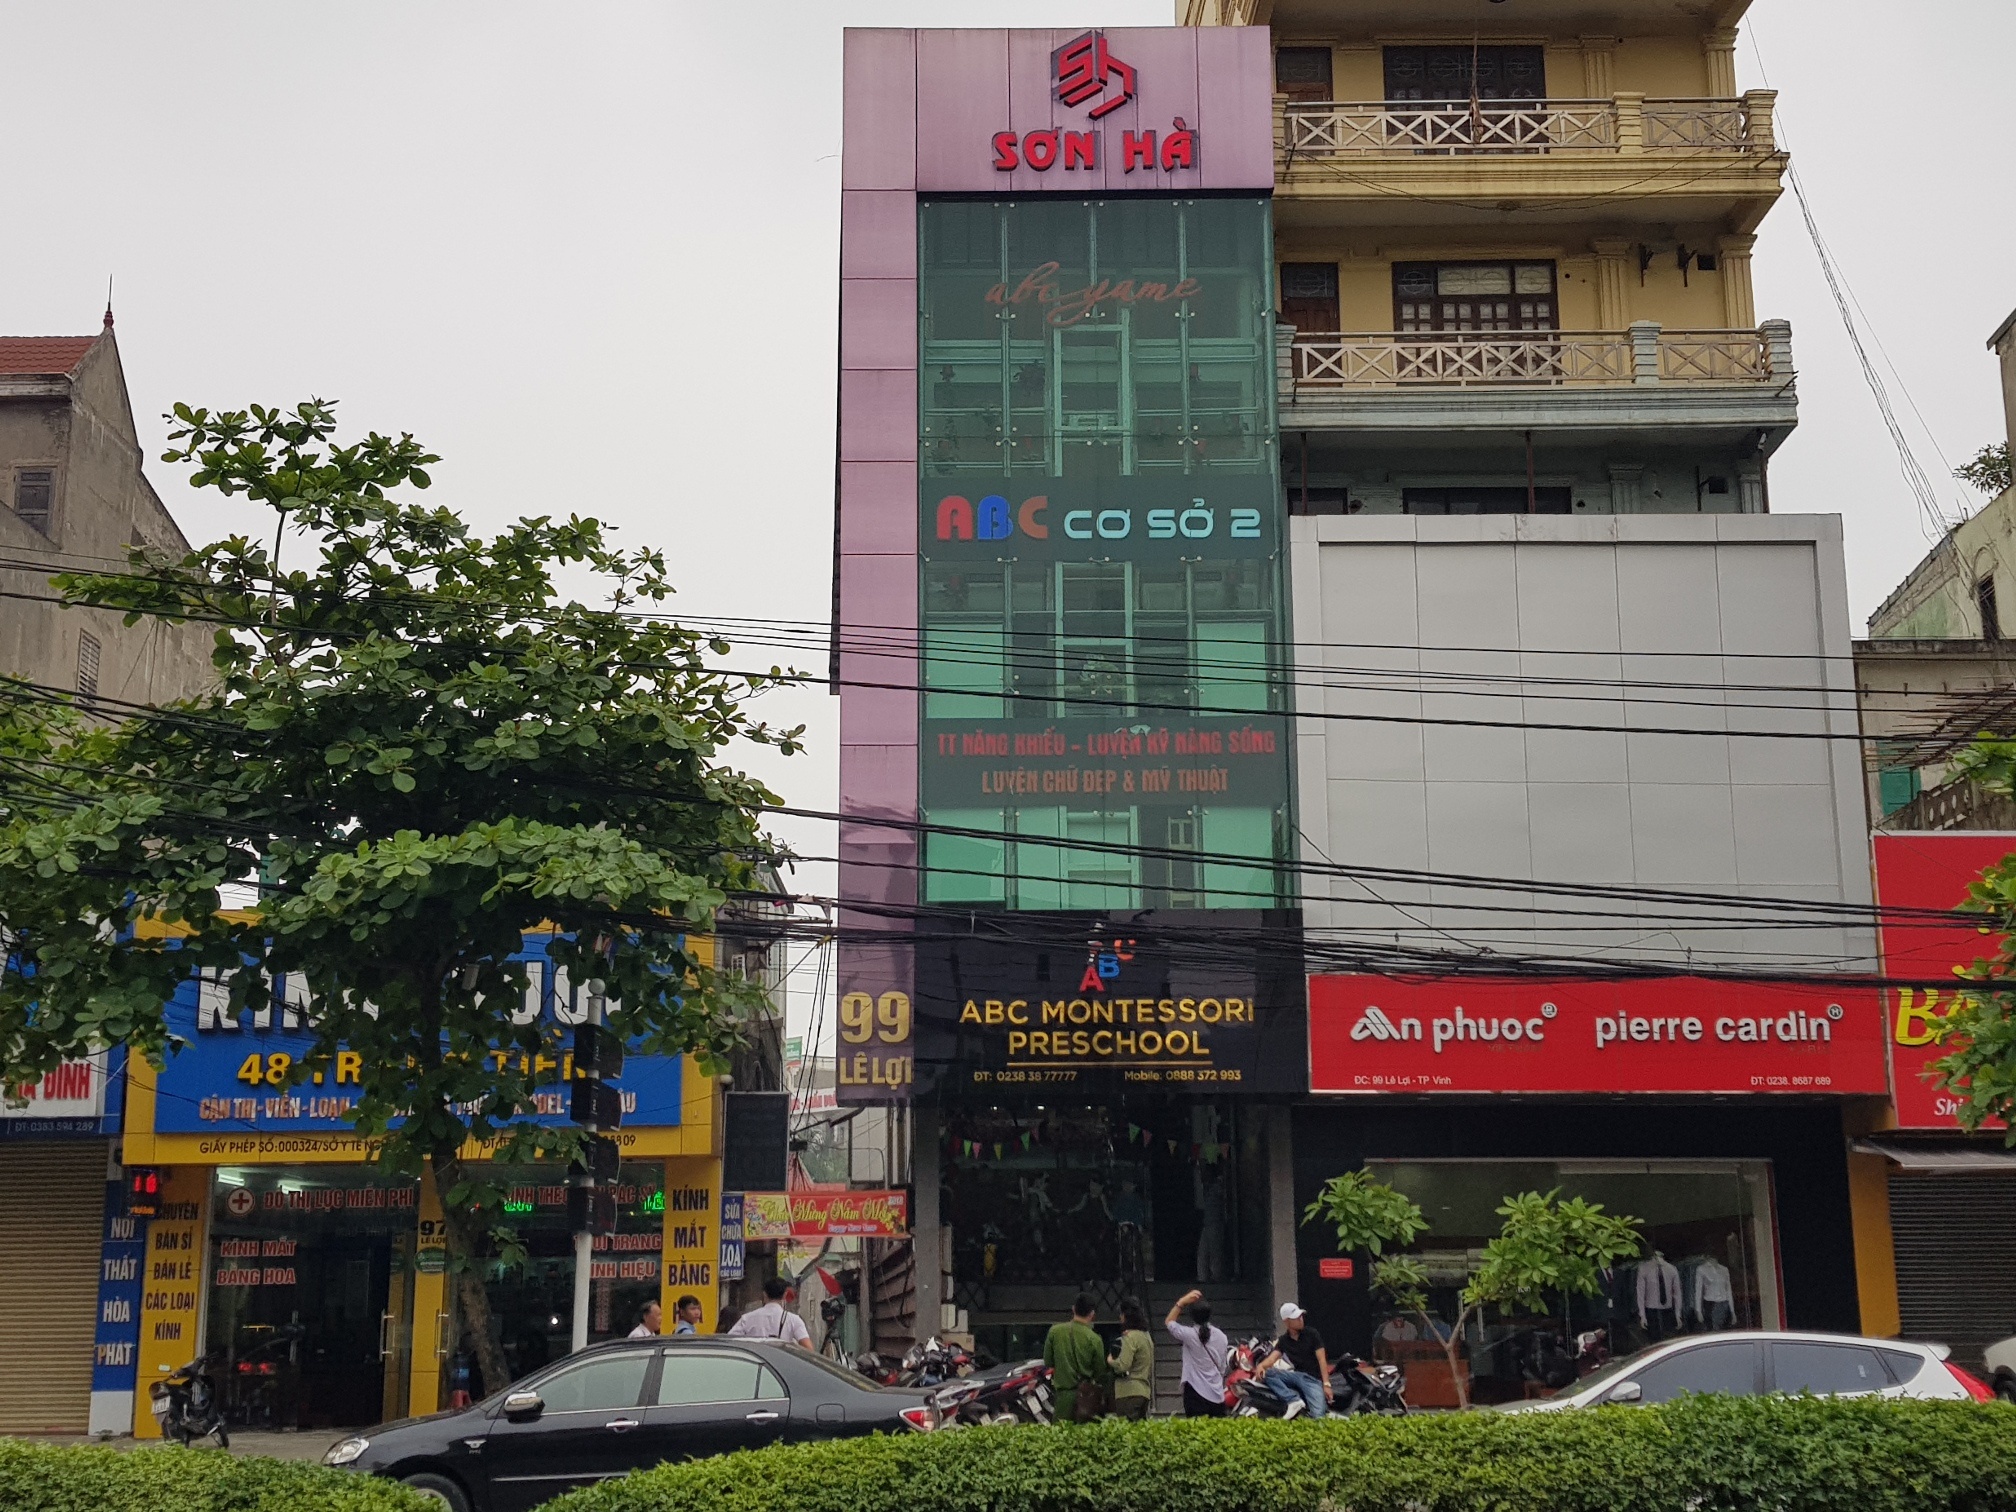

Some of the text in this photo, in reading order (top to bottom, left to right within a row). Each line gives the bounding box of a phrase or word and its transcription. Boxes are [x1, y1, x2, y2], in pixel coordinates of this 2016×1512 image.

[991, 116, 1198, 175] SƠN HÀ
[936, 494, 1261, 541] ABC CƠ SỞ 2
[937, 733, 957, 757] TT
[962, 728, 1009, 757] NĂNG
[1014, 725, 1066, 757] KHIẾU
[1088, 728, 1142, 760] LUYỆN
[1147, 727, 1170, 756] KỸ
[1175, 727, 1222, 756] NĂNG
[1228, 724, 1275, 755] SỐNG
[982, 764, 1229, 796] LUYỆN CHỮ ĐẸP & MỸ THUẬT
[840, 990, 911, 1044] 99
[959, 998, 1255, 1025] ABC MONTESSORI
[1432, 1006, 1545, 1053] phuoc
[1595, 1010, 1831, 1048] pierre cardin
[1008, 1030, 1210, 1056] PRESCHOOL
[839, 1052, 912, 1091] LÊ LỢI
[973, 1071, 992, 1082] ĐT:
[996, 1071, 1026, 1082] 0238
[1043, 1071, 1078, 1082] 77777
[1123, 1070, 1163, 1081] Mobile:
[1165, 1070, 1195, 1081] 0888
[1220, 1070, 1242, 1081] 993
[1372, 1075, 1384, 1085] 99
[1385, 1075, 1396, 1085] Lê
[1418, 1075, 1430, 1085] TP
[1432, 1075, 1453, 1085] Vinh
[199, 1093, 231, 1123] CẬN
[200, 1137, 227, 1154] GIẤY
[229, 1138, 256, 1153] PHÉP
[672, 1184, 710, 1211] KÍNH
[155, 1229, 179, 1250] BÁN
[419, 1220, 447, 1236] 97
[674, 1219, 707, 1249] MẮT
[221, 1238, 260, 1258] KÍNH
[612, 1233, 662, 1251] TRANG
[104, 1252, 137, 1281] THẤT
[721, 1243, 742, 1268] LOA
[153, 1259, 176, 1280] BÁN
[262, 1267, 297, 1285] HOA
[620, 1257, 657, 1281] HIỆU
[103, 1296, 130, 1323] HÒA
[145, 1289, 195, 1313] CÁC LOẠI
[154, 1319, 182, 1341] KÍNH
